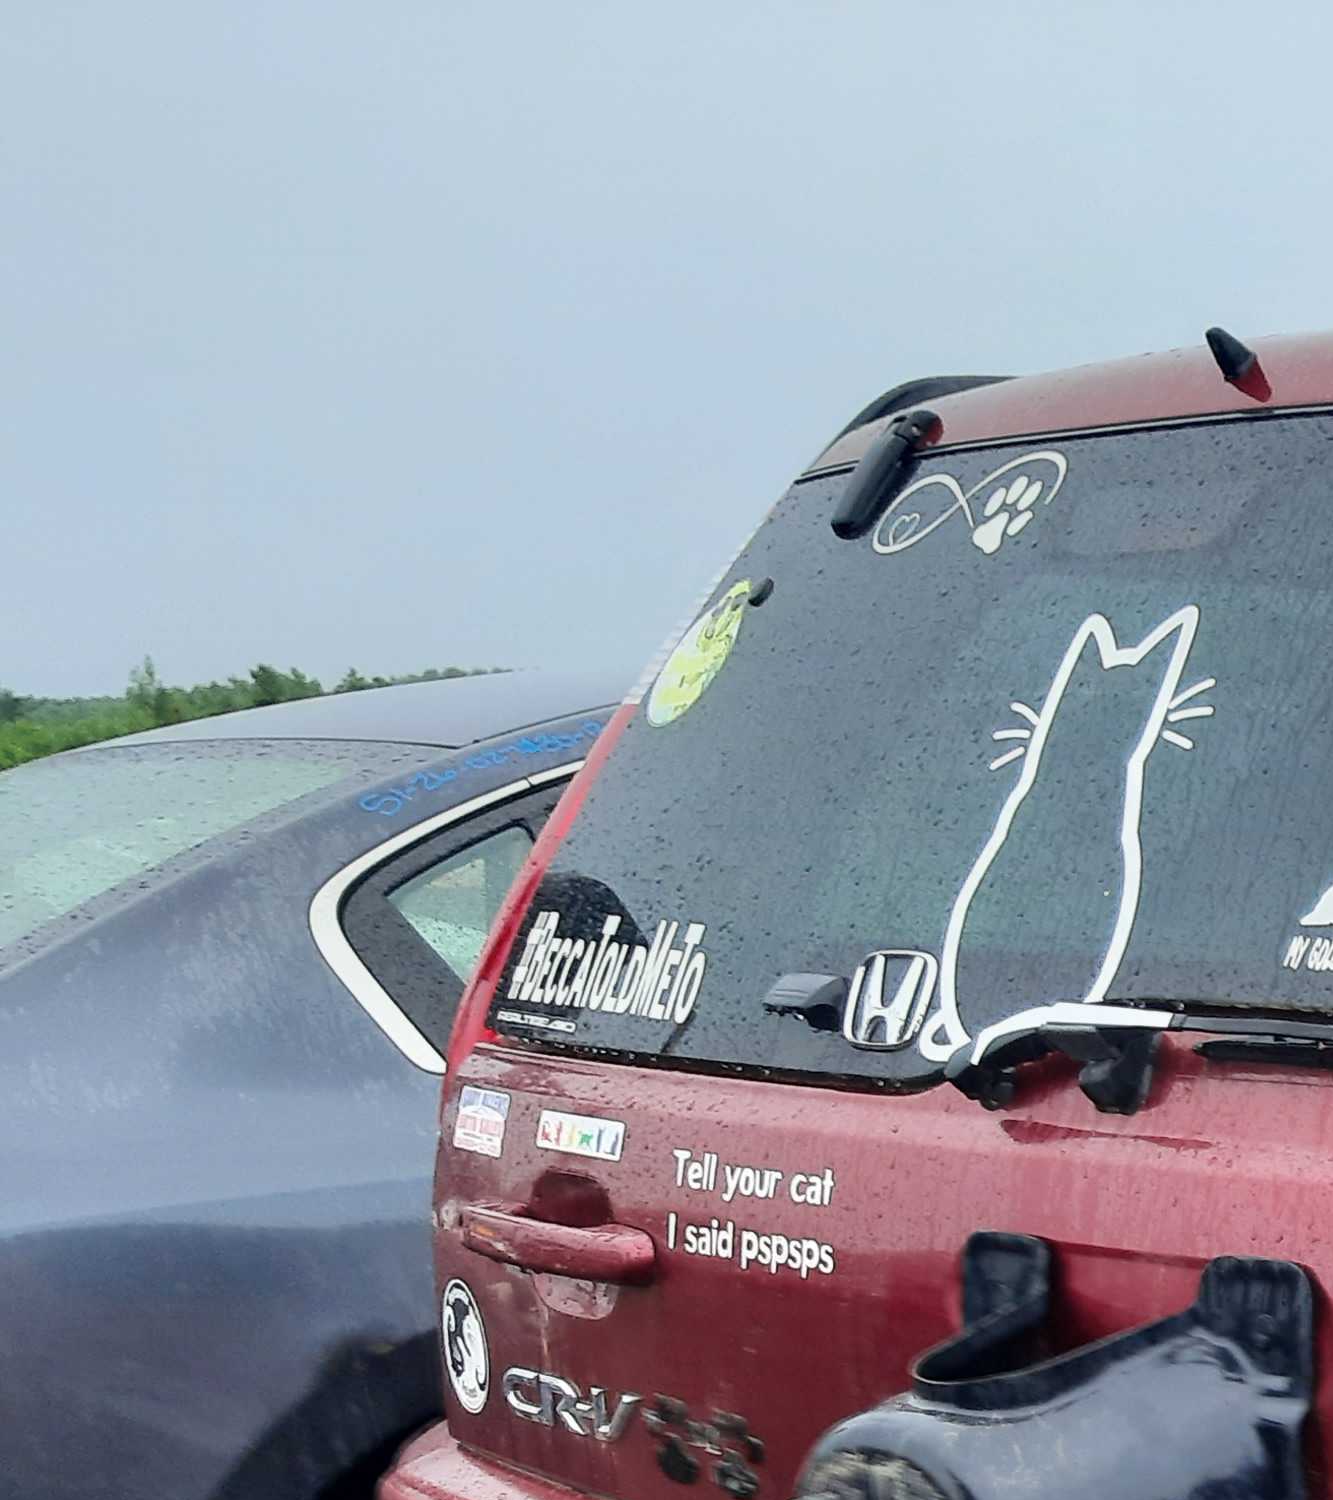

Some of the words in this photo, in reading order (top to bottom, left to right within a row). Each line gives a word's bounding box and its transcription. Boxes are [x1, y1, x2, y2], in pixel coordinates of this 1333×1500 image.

[673, 1149, 718, 1191] Tell
[722, 1165, 783, 1202] your
[790, 1168, 835, 1205] cat
[668, 1212, 677, 1250] I
[684, 1219, 735, 1259] said
[740, 1231, 835, 1279] pspsps
